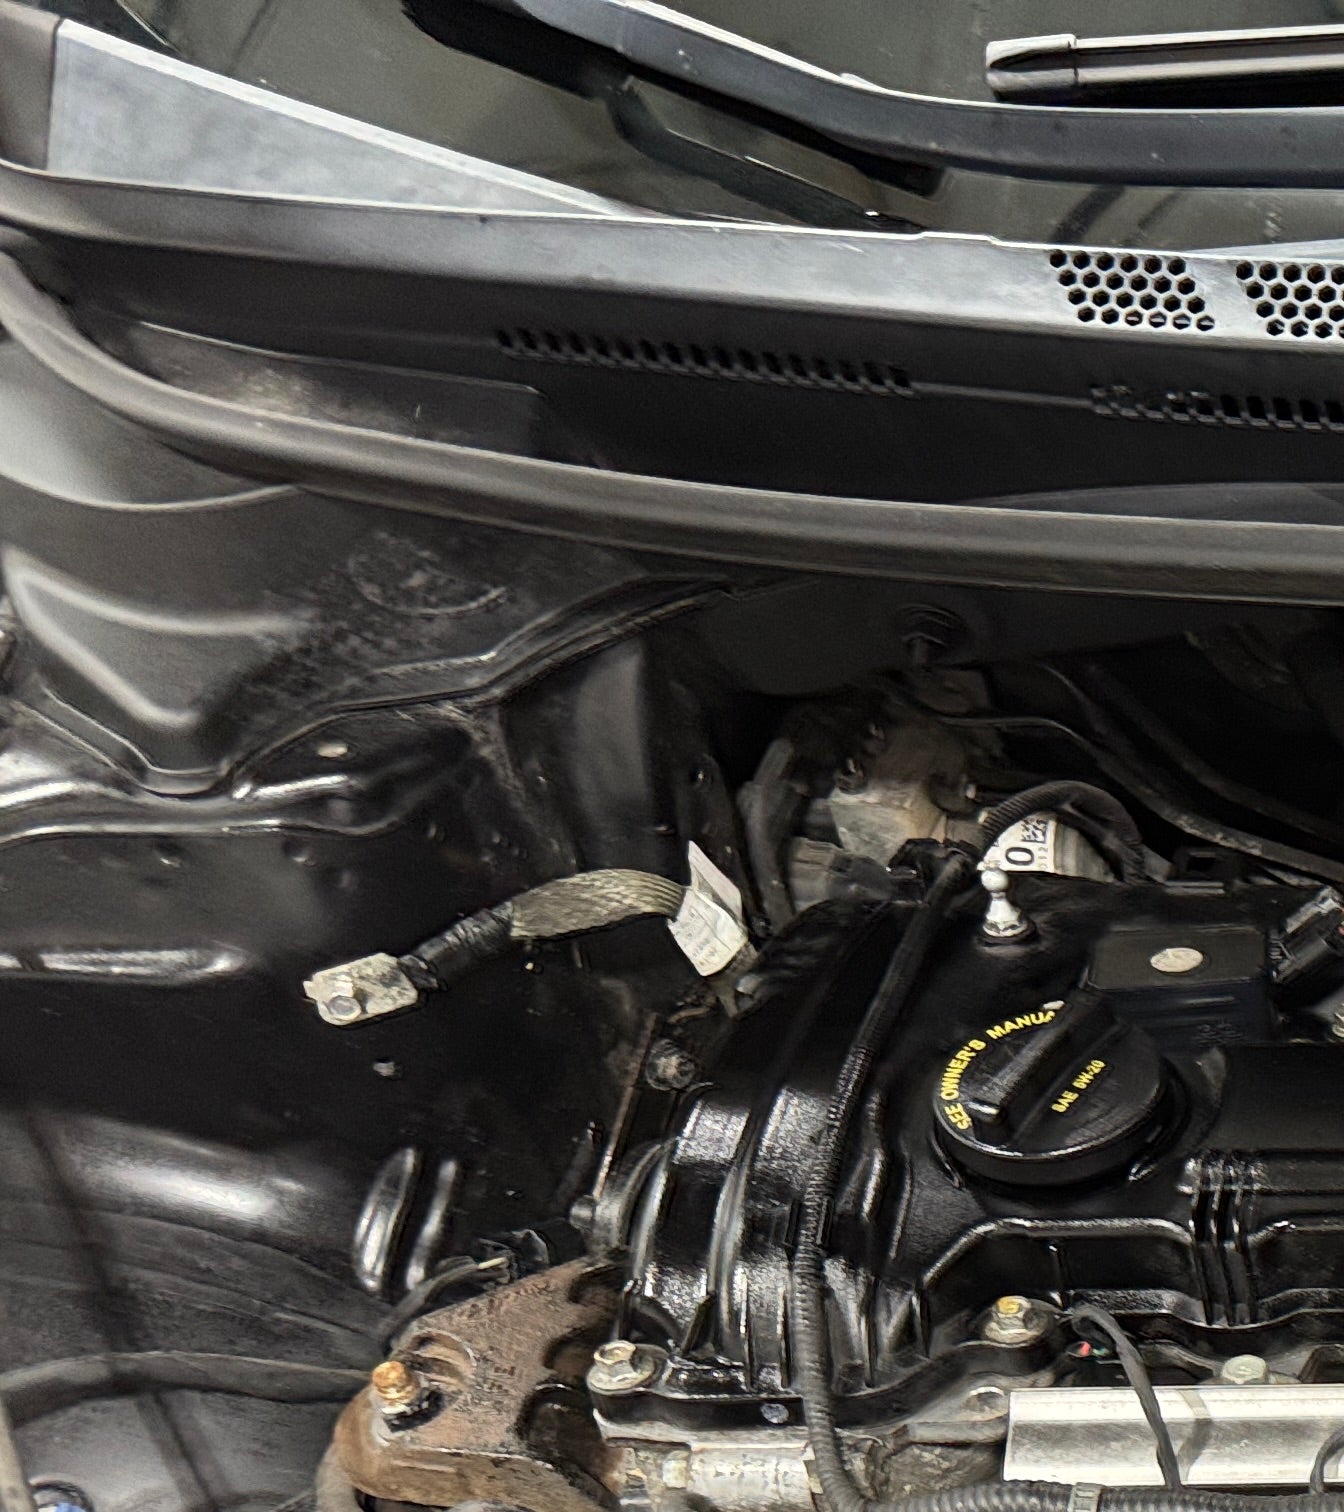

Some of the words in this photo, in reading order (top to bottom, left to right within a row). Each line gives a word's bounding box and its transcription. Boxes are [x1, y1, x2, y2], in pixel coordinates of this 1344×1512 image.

[986, 1011, 1056, 1040] MANUA
[940, 1039, 987, 1101] OWNER'S
[944, 1103, 972, 1130] SEE
